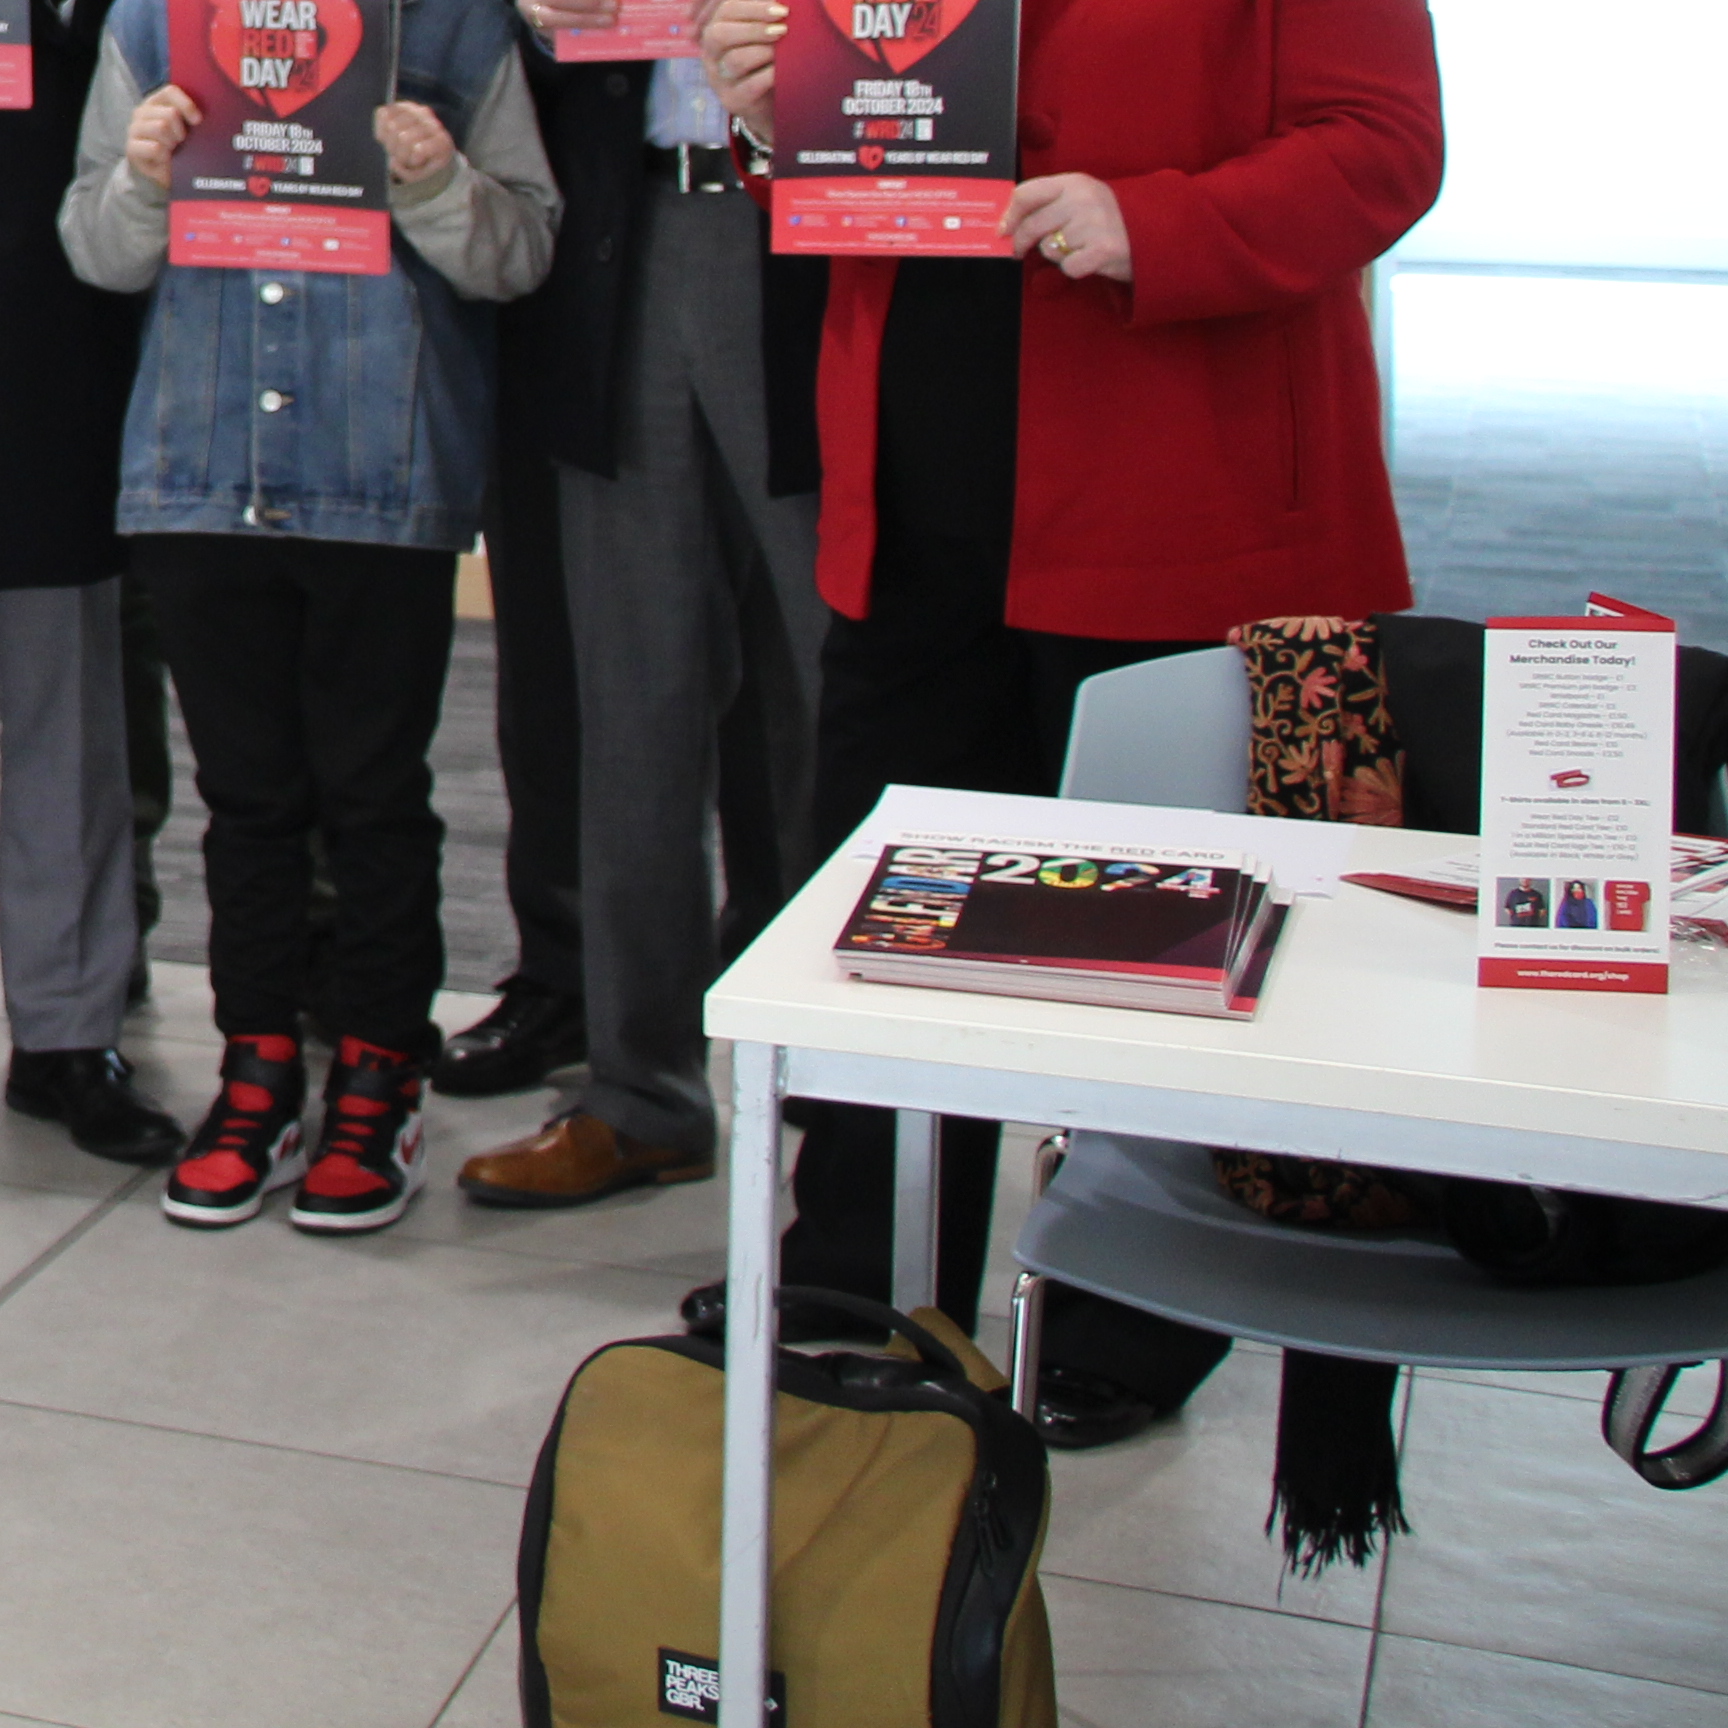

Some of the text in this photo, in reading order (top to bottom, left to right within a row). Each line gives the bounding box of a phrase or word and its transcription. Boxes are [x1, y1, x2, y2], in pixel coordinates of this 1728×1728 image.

[853, 3, 912, 40] DAY
[243, 29, 294, 58] RED
[241, 57, 293, 89] DAY
[854, 80, 903, 97] FRIDAY
[842, 97, 943, 115] OCTOBER 2024
[243, 120, 287, 139] FRIDAY
[233, 134, 323, 154] OCTOBER 2024
[1528, 639, 1618, 649] Check Out Our
[1509, 654, 1636, 667] Merchandise Today!
[900, 831, 1226, 861] SHOW RACISM THE RED CARD
[980, 852, 1222, 899] 2024
[665, 1659, 719, 1686] THREE
[666, 1674, 720, 1700] PEAKS
[666, 1688, 705, 1711] GBR.
